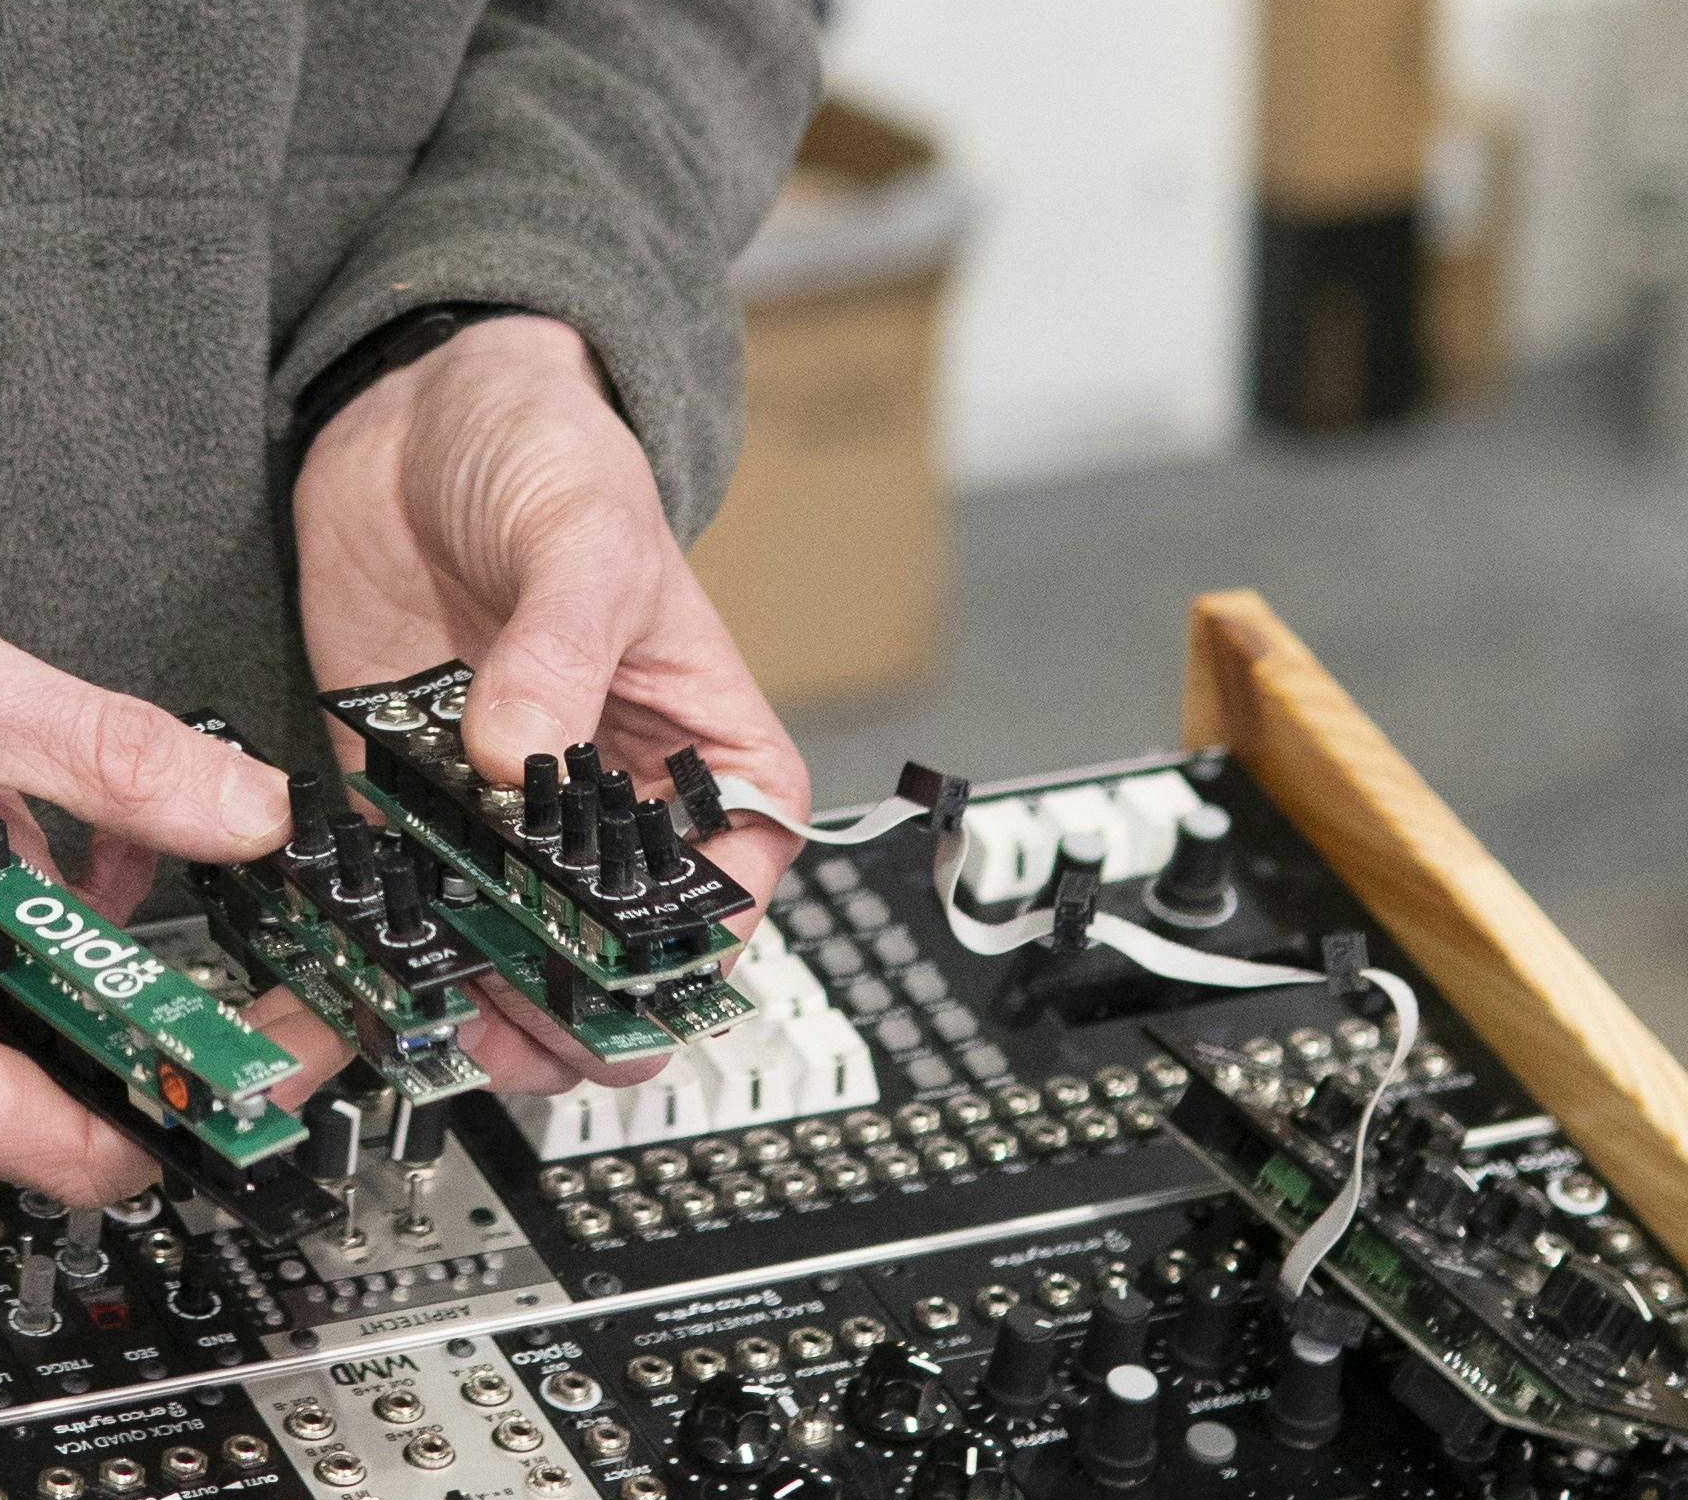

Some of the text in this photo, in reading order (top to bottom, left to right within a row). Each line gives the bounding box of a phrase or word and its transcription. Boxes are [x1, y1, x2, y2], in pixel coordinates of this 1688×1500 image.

[614, 901, 680, 922] CV MIX
[15, 897, 139, 968] pico
[359, 1305, 470, 1337] ARPITECHT
[197, 1333, 237, 1346] RND
[123, 1347, 160, 1360] SEQ
[512, 1344, 563, 1365] pico
[35, 1359, 94, 1375] TRIGG
[329, 1354, 421, 1386] WMD
[53, 1406, 166, 1434] erica synths
[54, 1418, 205, 1455] BLACK QUAD VCA
